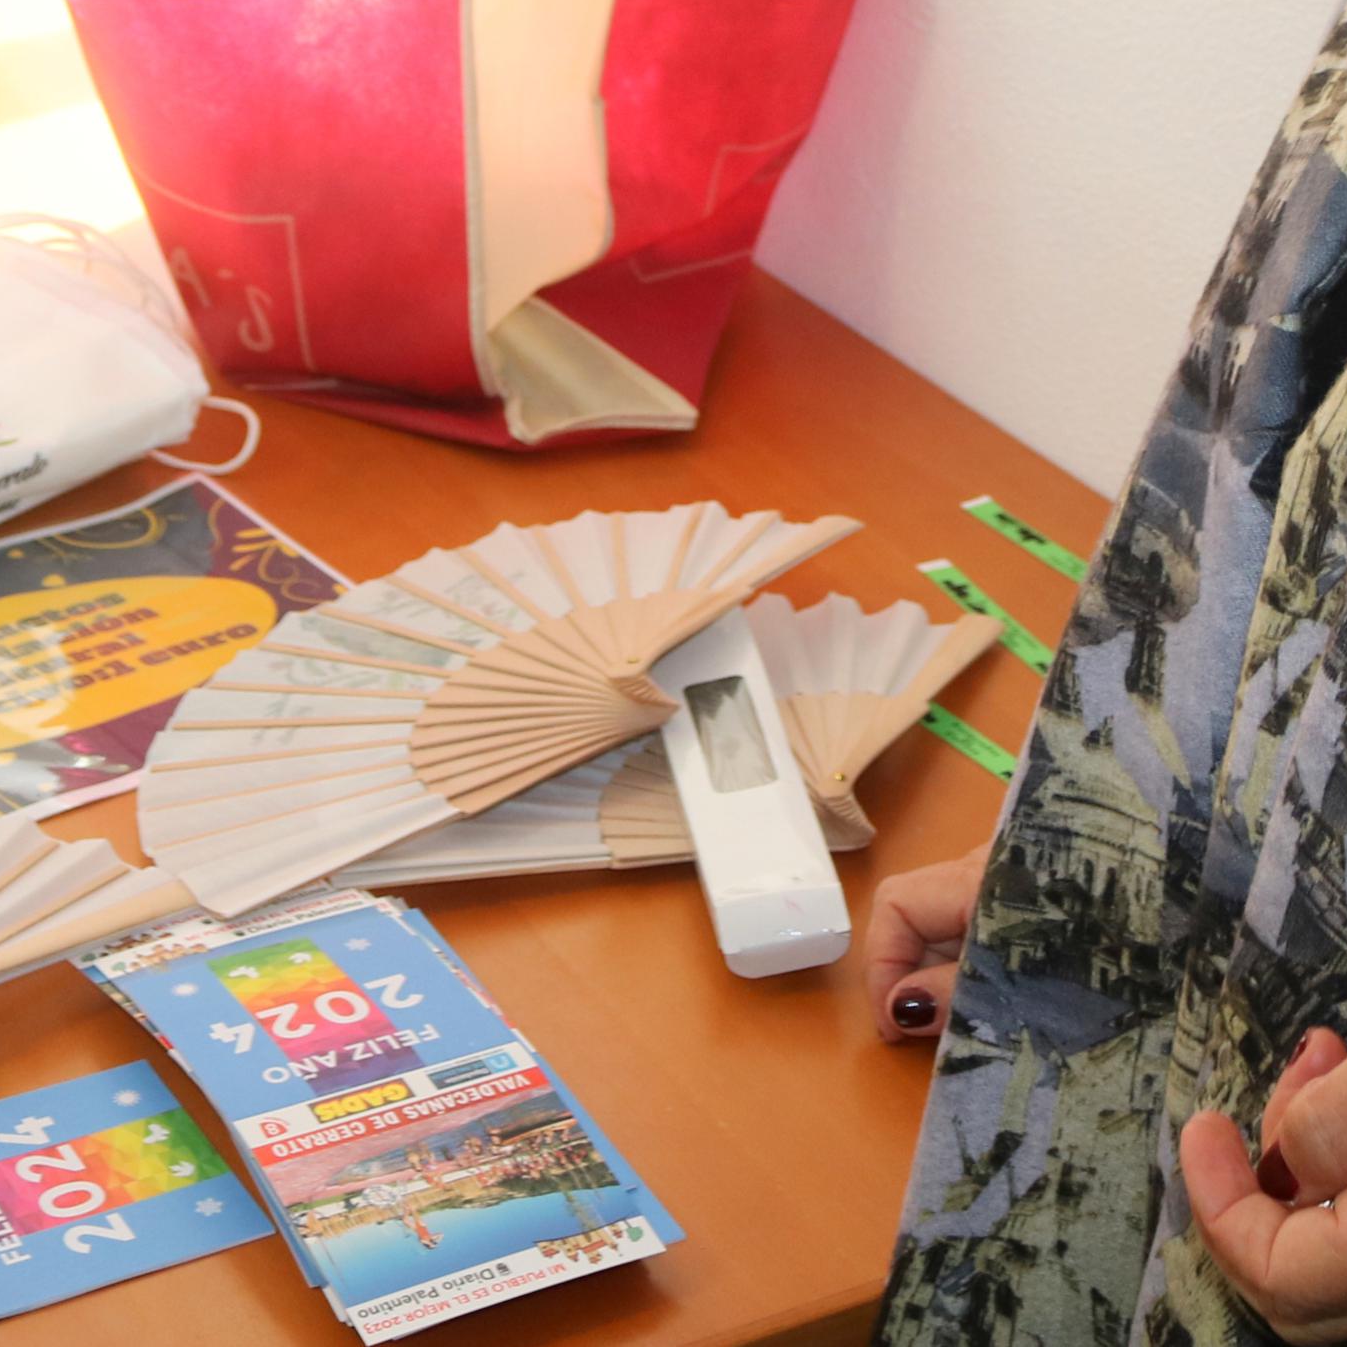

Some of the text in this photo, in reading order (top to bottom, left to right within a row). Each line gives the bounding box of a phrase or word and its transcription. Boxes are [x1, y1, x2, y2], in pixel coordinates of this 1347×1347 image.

[139, 623, 258, 666] euro
[209, 973, 425, 1054] 2024
[261, 1023, 441, 1084] FELIZ AÑO
[271, 1073, 532, 1158] VALDECAÑAS DE CERRATO
[313, 1083, 410, 1122] GADIS
[357, 1264, 496, 1319] Diario Palentino
[473, 1287, 490, 1301] ES
[491, 1267, 547, 1294] PUEBLO
[405, 1299, 452, 1324] MEJOR
[454, 1294, 472, 1307] EL
[363, 1315, 404, 1336] 2023
